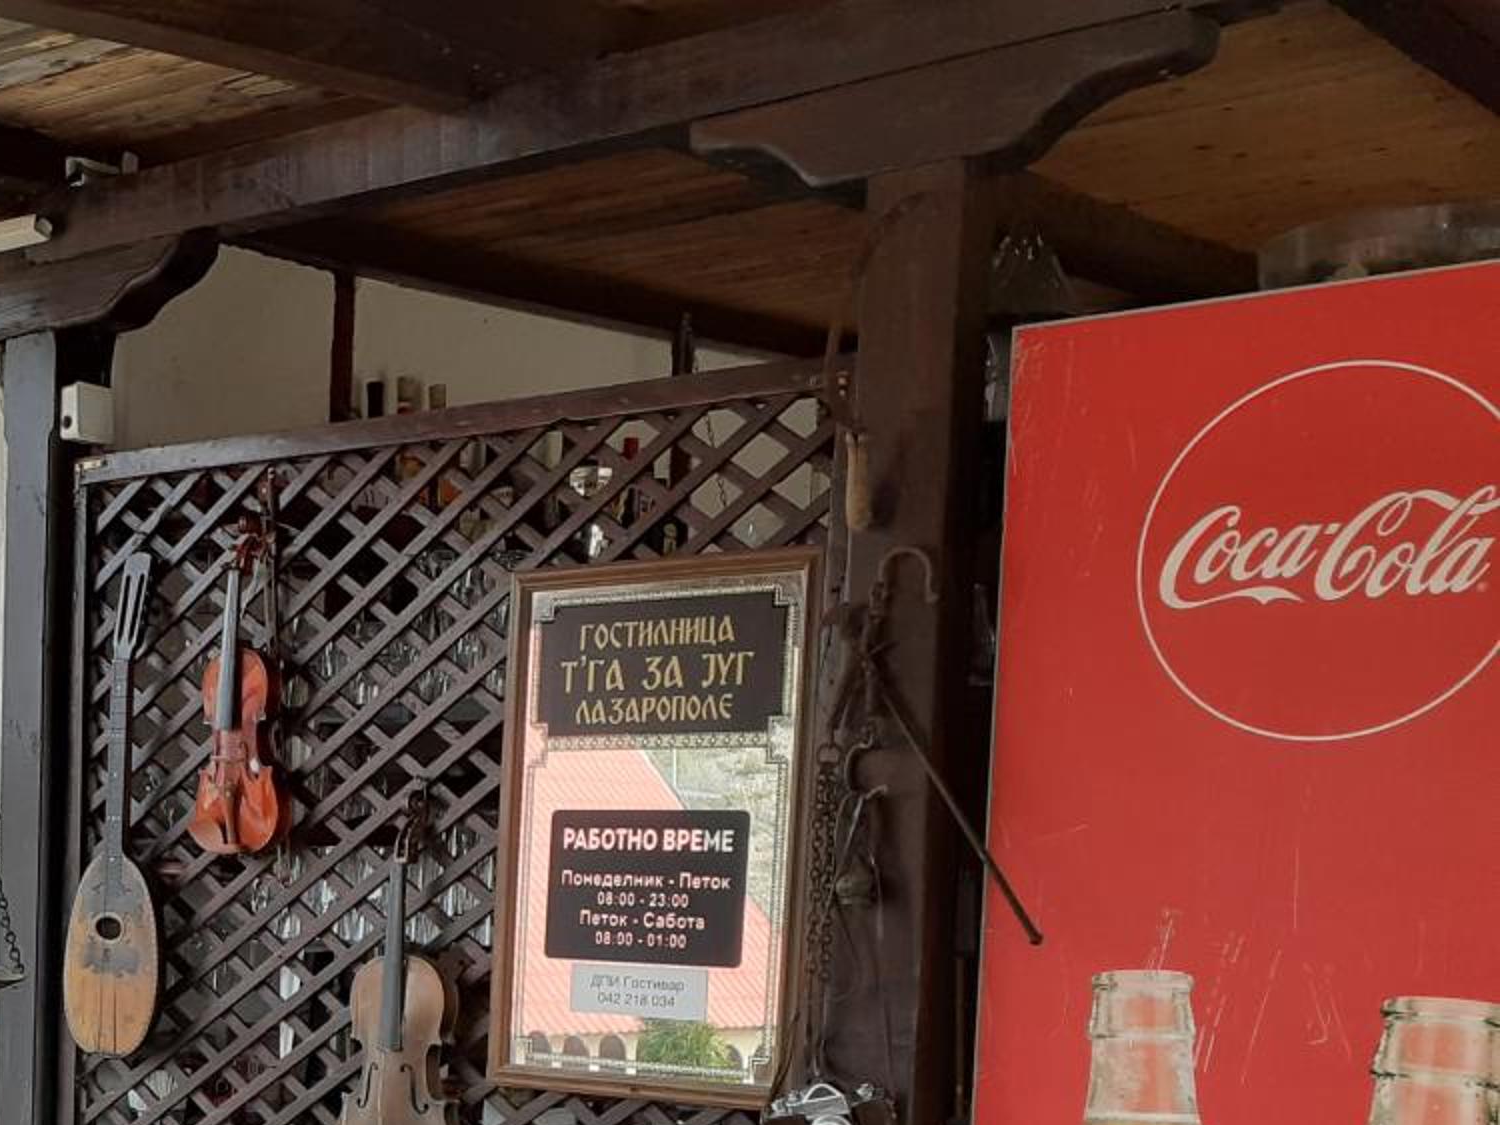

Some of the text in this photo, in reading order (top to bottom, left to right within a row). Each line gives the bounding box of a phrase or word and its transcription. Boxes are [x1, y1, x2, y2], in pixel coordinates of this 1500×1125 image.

[1160, 485, 1500, 609] Coca-Cola
[580, 615, 736, 651] ГОСТИЛНИЦА
[642, 655, 684, 691] ЗА
[701, 651, 755, 689] ЈУГ
[575, 693, 733, 725] ЛАЗАРОПОЛЕ
[563, 827, 735, 852] РАБОТНО ВРЕМЕ
[561, 870, 664, 889] Понеделник
[679, 872, 732, 890] Петок
[597, 891, 635, 906] 08:00
[649, 893, 689, 908] 23:00
[579, 909, 628, 926] Петок
[643, 912, 706, 930] Сабота
[595, 931, 633, 946] 08:00
[647, 933, 687, 948] 01:00
[624, 975, 685, 994] Гостивар
[597, 991, 621, 1006] 042
[651, 995, 676, 1008] 034
